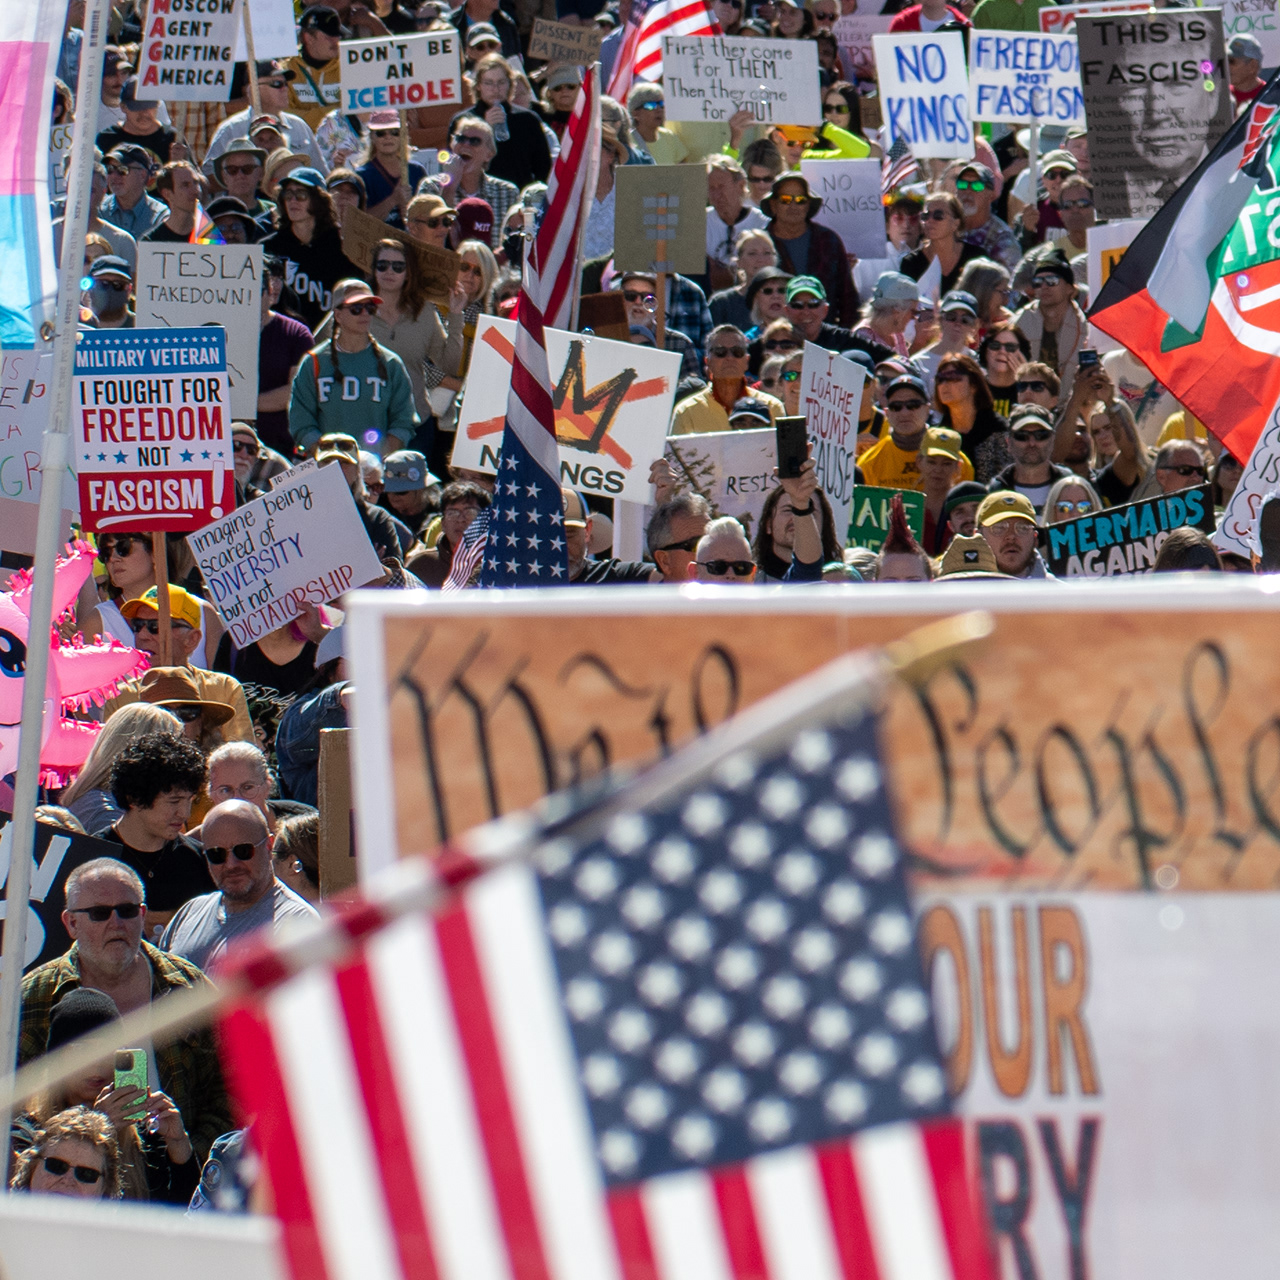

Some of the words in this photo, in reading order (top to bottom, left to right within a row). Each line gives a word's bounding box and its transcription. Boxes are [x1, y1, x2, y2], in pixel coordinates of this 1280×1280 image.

[149, 17, 213, 38] AGENT
[534, 22, 585, 41] DISSENT
[1093, 20, 1169, 46] THIS
[1180, 20, 1207, 41] IS
[148, 40, 231, 62] GRIFTING
[347, 41, 408, 64] DON'T
[428, 39, 453, 56] BE
[665, 37, 706, 57] First
[711, 37, 747, 61] they
[751, 44, 793, 61] come
[386, 62, 414, 80] AN
[693, 60, 721, 79] for
[894, 43, 947, 84] NO
[142, 65, 226, 87] AMERICA
[1016, 73, 1053, 85] NOT
[347, 79, 455, 110] ICEHOLE
[667, 78, 706, 98] Then
[710, 78, 746, 102] they
[749, 88, 788, 102] come
[701, 101, 727, 120] for
[886, 94, 970, 144] KINGS
[822, 176, 852, 192] NO
[473, 221, 492, 232] MIT
[152, 251, 257, 281] TESLA
[147, 285, 252, 306] TAKEDOWN!
[76, 348, 146, 369] MILITARY
[149, 346, 221, 367] VETERAN
[828, 355, 834, 378] I
[80, 379, 87, 406] I
[94, 379, 175, 406] FOUGHT
[181, 378, 222, 403] FOR
[810, 370, 854, 416] LOATHE
[82, 406, 224, 443] FREEDOM
[806, 396, 850, 447] TRUMP
[137, 447, 171, 467] NOT
[195, 502, 257, 554] imagine
[263, 482, 314, 523] being
[1049, 489, 1205, 560] MERMAIDS
[201, 533, 257, 578] scared
[260, 518, 277, 549] of
[210, 532, 304, 601] DIVERSITY
[218, 596, 244, 623] but
[247, 580, 275, 610] not
[231, 564, 355, 648] DICTATORSHIP
